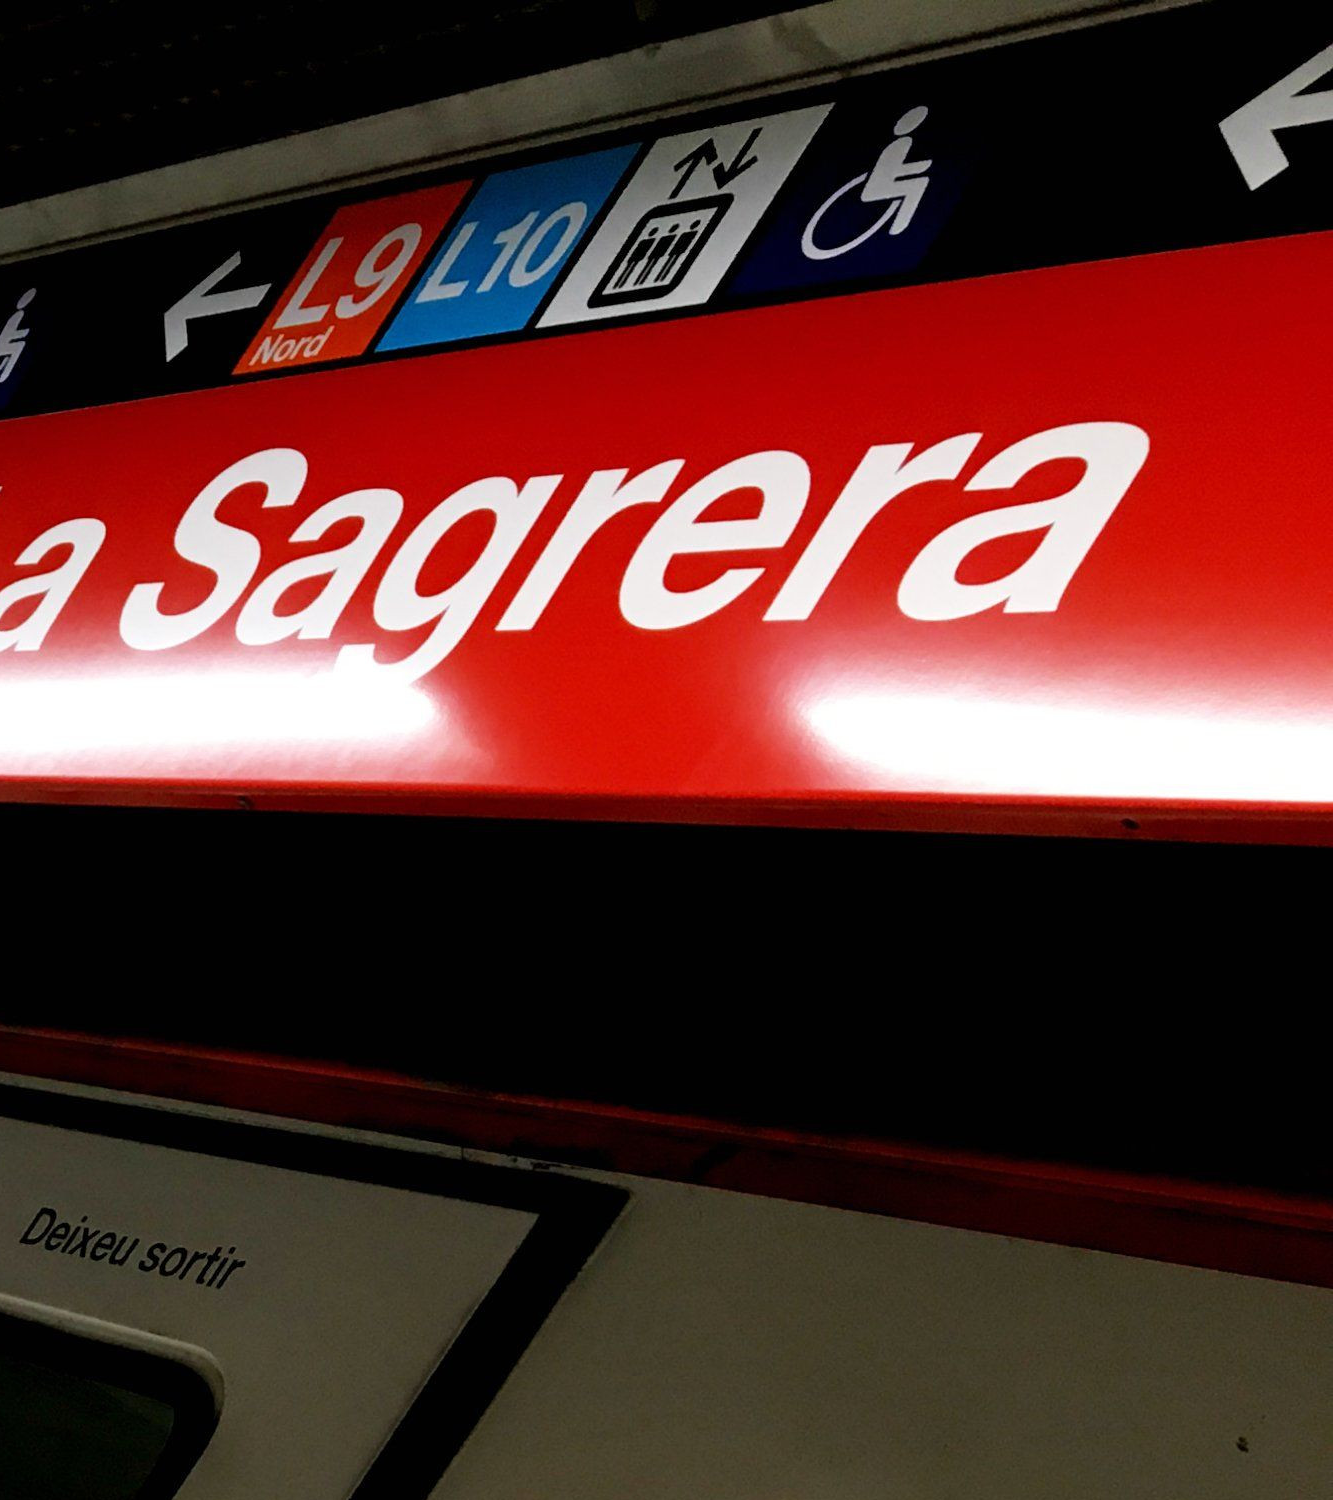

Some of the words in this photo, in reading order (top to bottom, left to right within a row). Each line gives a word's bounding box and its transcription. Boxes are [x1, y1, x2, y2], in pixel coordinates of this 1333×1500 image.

[272, 223, 423, 331] L9
[414, 200, 588, 304] L10
[248, 325, 334, 367] Nord
[119, 421, 1150, 687] Sagrera
[19, 1207, 140, 1266] Deixeu
[138, 1242, 246, 1289] sortir
